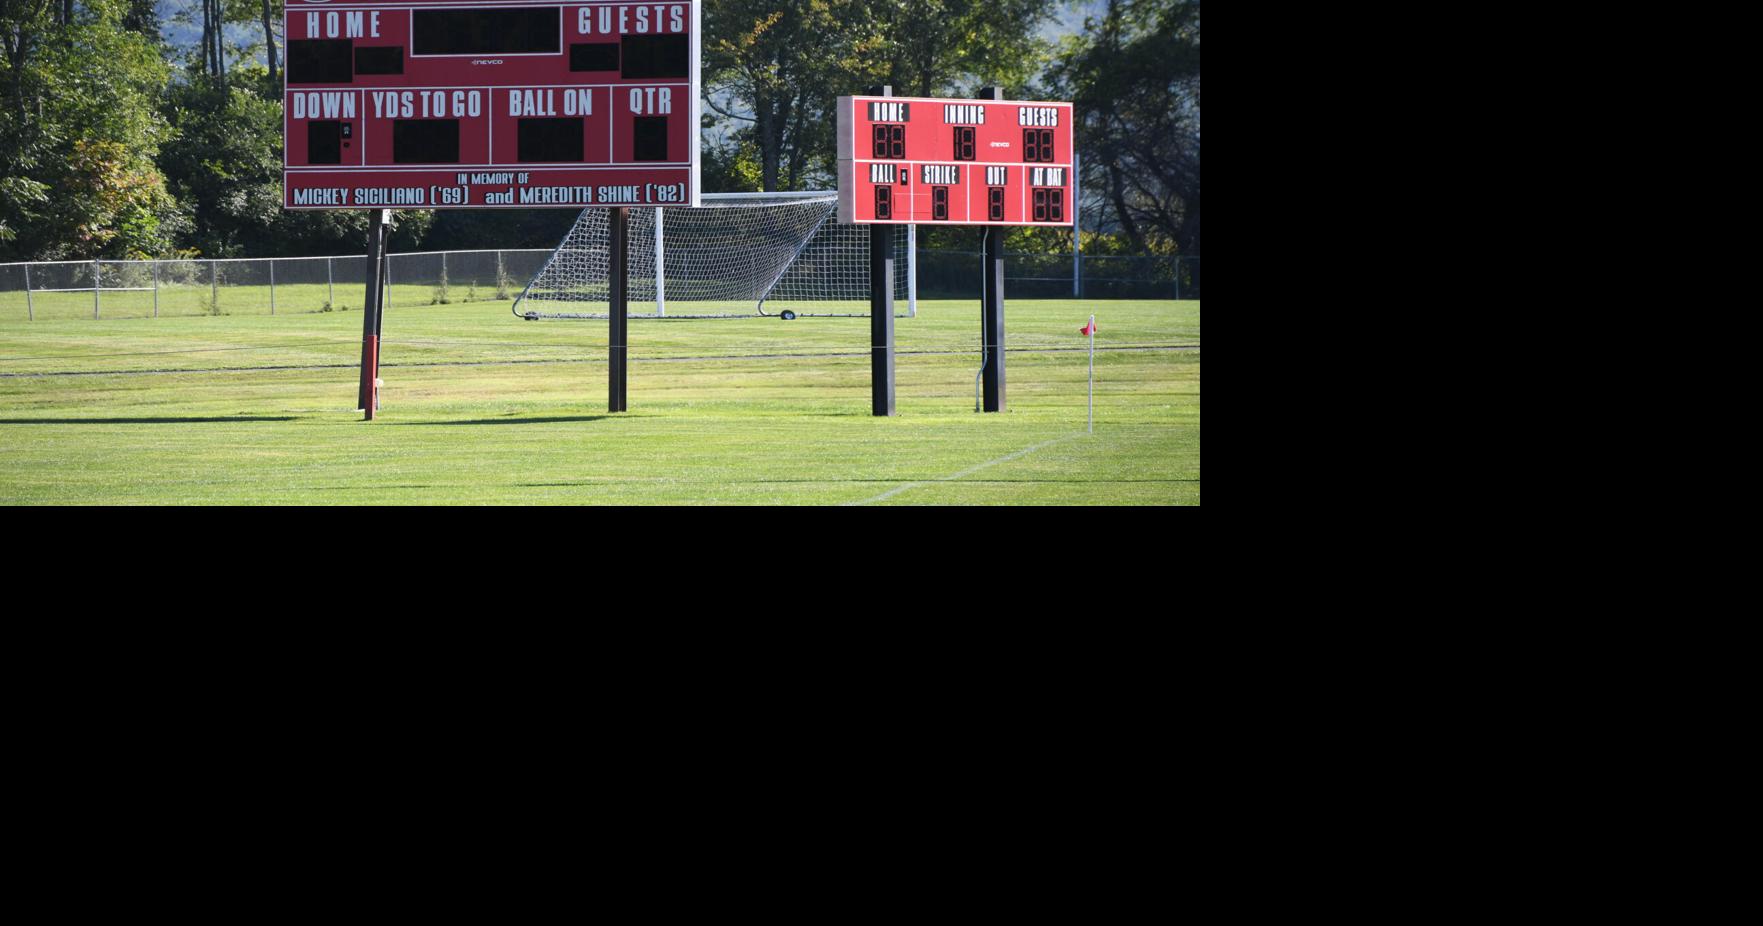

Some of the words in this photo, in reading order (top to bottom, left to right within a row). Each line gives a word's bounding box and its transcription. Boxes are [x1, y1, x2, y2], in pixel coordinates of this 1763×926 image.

[306, 11, 381, 39] HOME
[577, 5, 684, 34] GUESTS
[293, 91, 356, 119] DOWN
[373, 90, 414, 118] YDS
[422, 90, 447, 118] TO
[452, 89, 482, 117] GO
[508, 89, 557, 117] BALL
[564, 88, 593, 116] ON
[628, 87, 673, 115] QTR
[873, 103, 904, 122] HOME
[944, 105, 985, 124] INNING
[1019, 107, 1058, 126] GUESTS
[456, 172, 469, 185] IN
[471, 172, 514, 185] MEMORY
[517, 172, 530, 184] OF
[871, 164, 895, 183] BALL
[924, 166, 957, 184] STRIKE
[987, 166, 1006, 185] OUT
[1033, 168, 1046, 186] AT
[1047, 168, 1063, 186] BAT
[293, 188, 349, 206] MICKEY
[354, 187, 425, 205] SICILIANO
[430, 185, 470, 205] ('69)
[485, 187, 514, 204] and
[519, 185, 593, 204] MEREDITH
[598, 184, 640, 203] SHINE
[645, 182, 686, 203] ('82)
